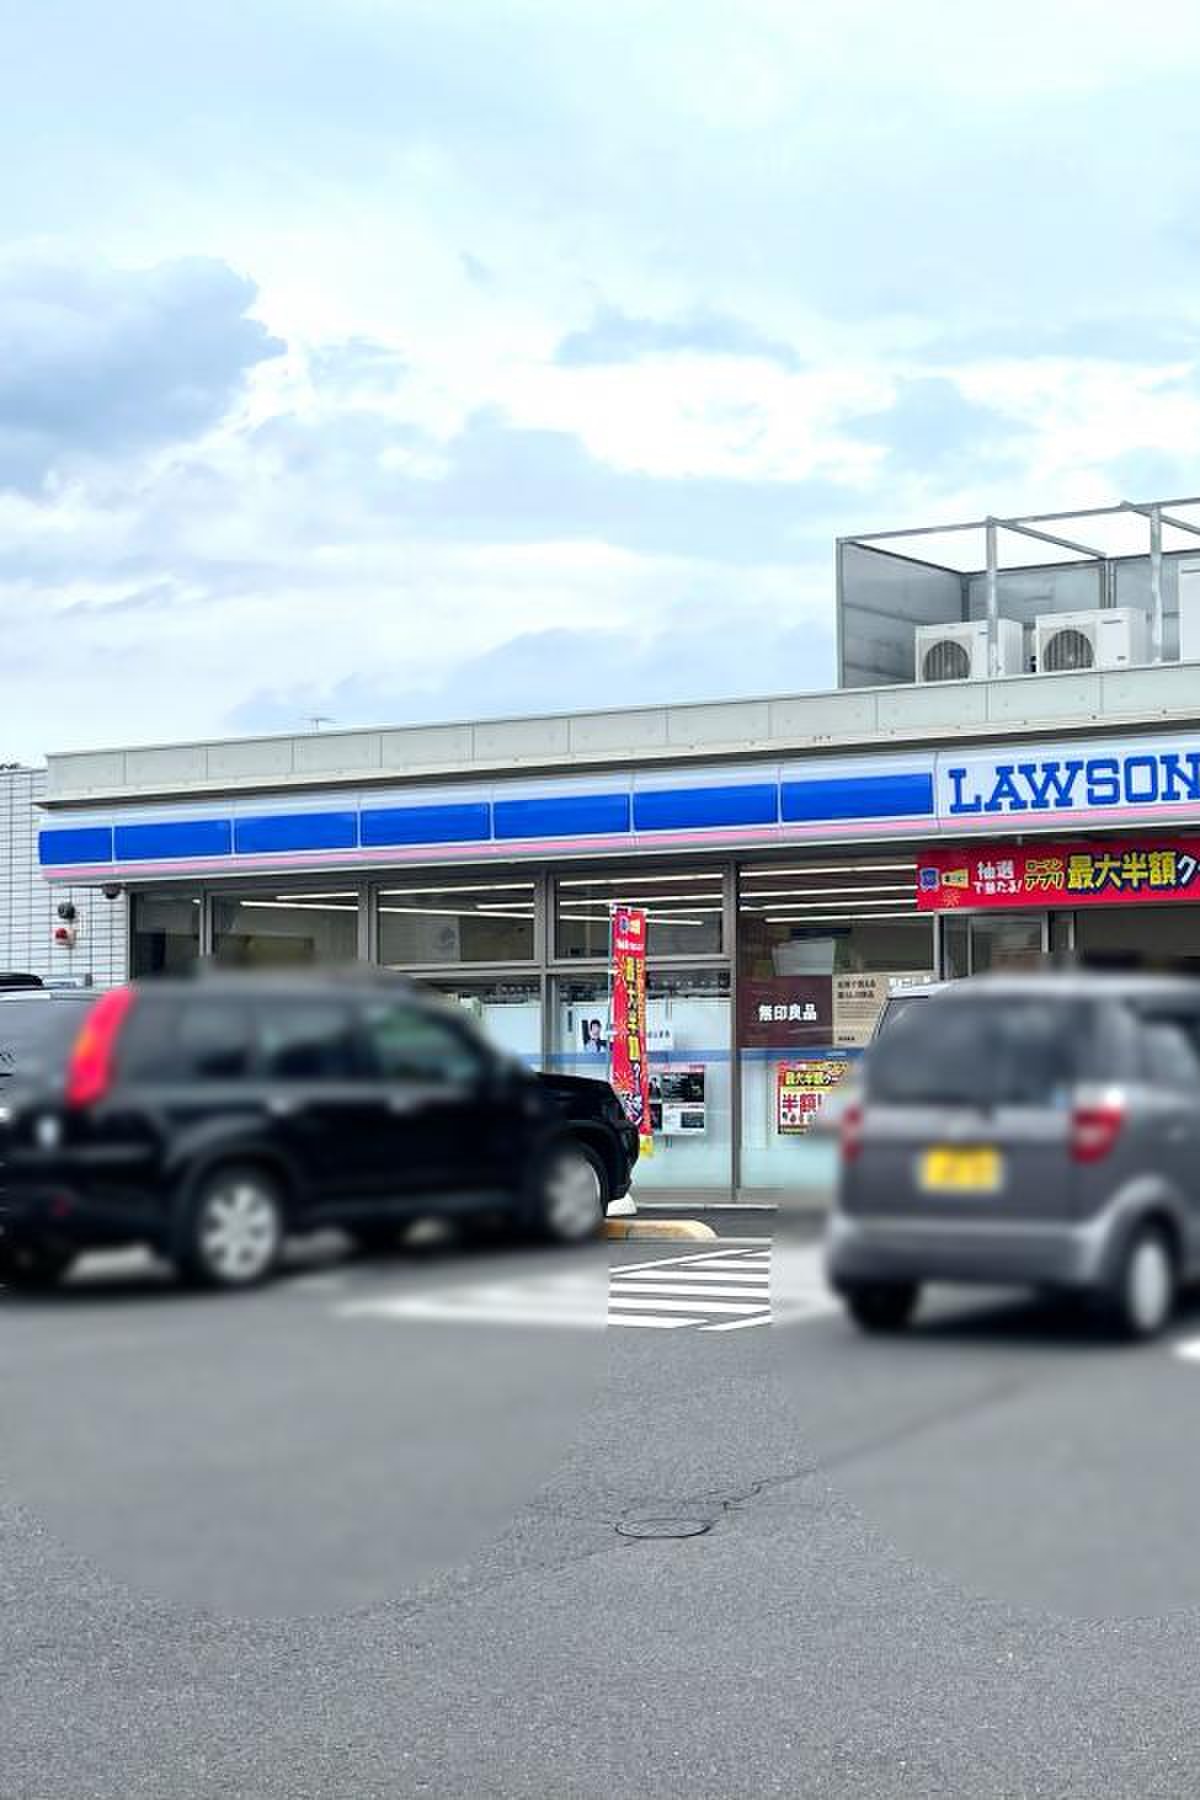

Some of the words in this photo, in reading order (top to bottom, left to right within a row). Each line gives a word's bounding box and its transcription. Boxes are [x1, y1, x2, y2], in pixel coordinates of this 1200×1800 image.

[976, 859, 1014, 880] 抽選
[1024, 872, 1065, 891] アプリ
[759, 1004, 817, 1021] 無印良品
